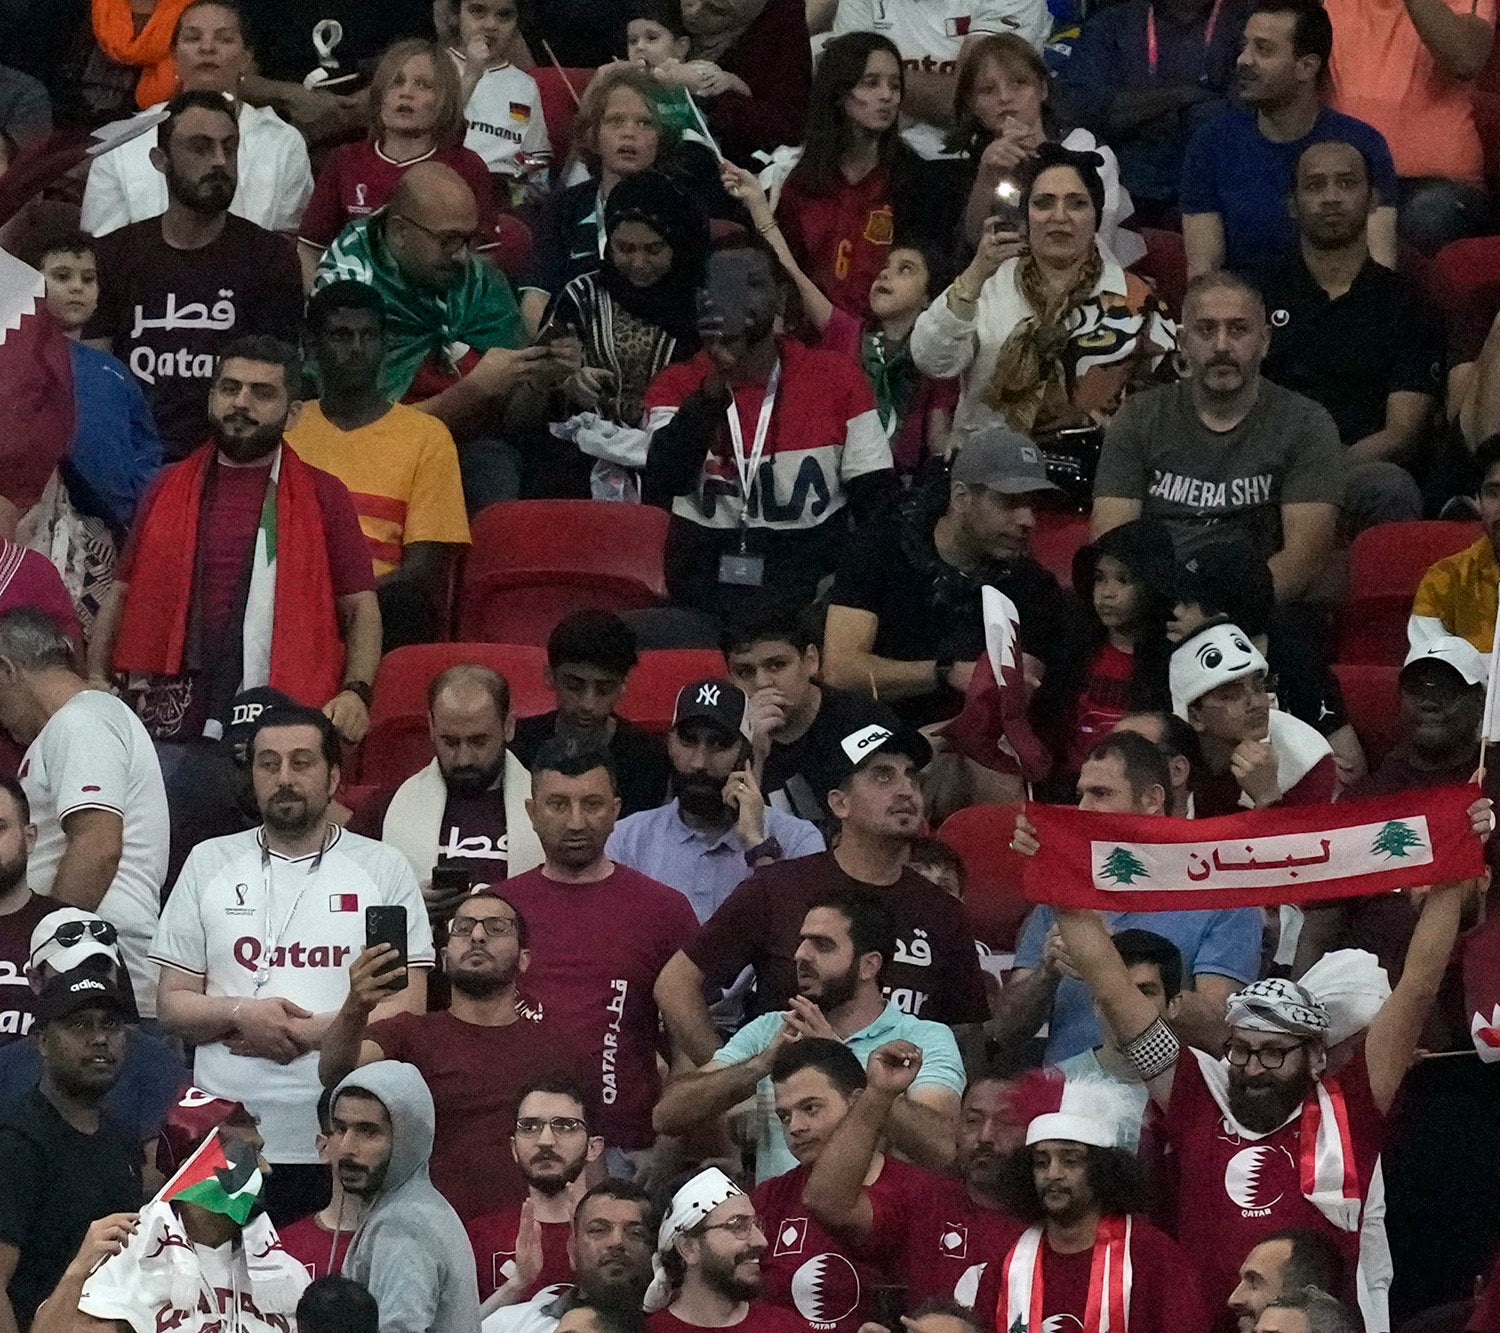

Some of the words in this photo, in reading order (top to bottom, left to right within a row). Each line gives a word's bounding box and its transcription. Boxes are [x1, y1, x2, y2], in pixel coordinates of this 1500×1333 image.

[466, 122, 522, 141] rmany
[131, 289, 235, 331] قطر
[130, 347, 213, 379] Qata
[1232, 474, 1272, 506] SHY
[1188, 838, 1331, 881] لبنان
[234, 937, 350, 972] Qatar
[602, 1034, 619, 1103] QATAR
[1241, 1208, 1271, 1218] QATAR
